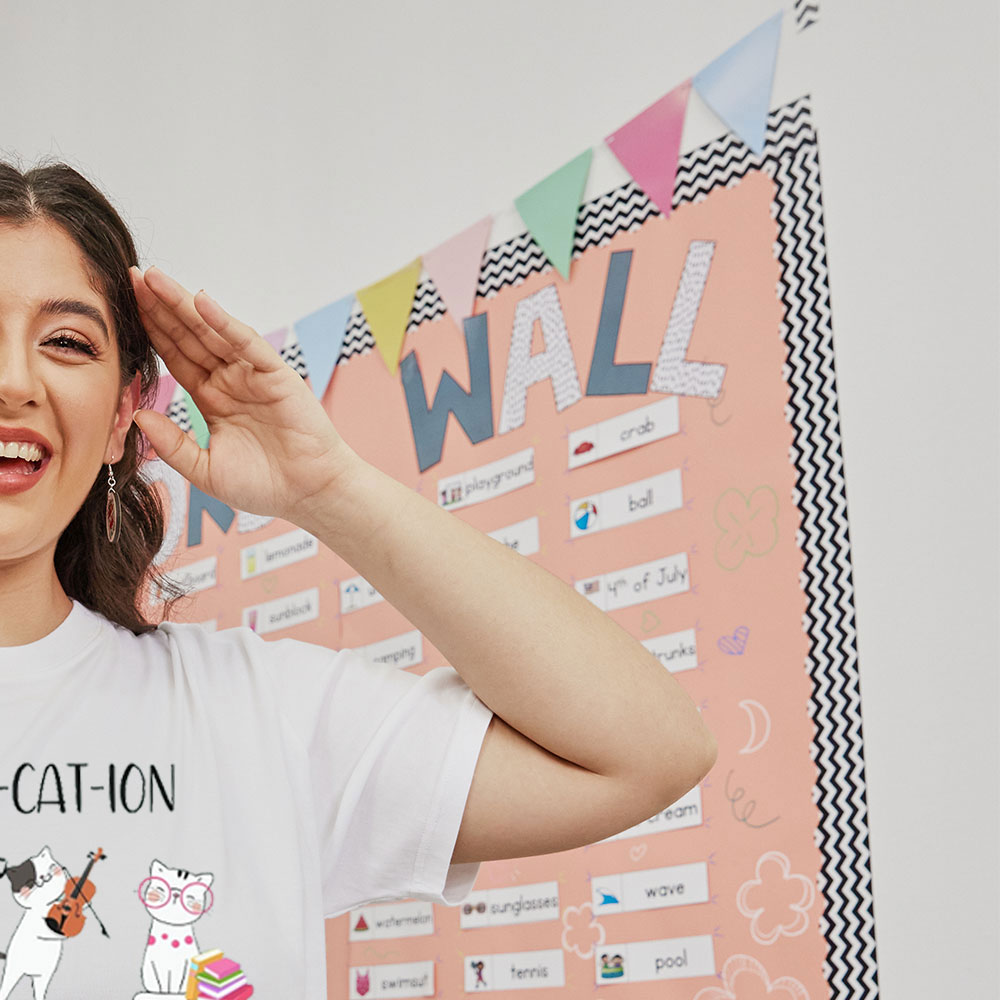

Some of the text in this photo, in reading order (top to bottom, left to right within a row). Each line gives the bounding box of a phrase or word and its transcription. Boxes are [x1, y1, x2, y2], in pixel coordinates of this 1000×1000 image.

[400, 240, 728, 474] WALL
[619, 416, 656, 443] crab
[464, 453, 535, 496] playground
[628, 488, 655, 512] ball
[265, 538, 314, 562] lemonade
[633, 571, 651, 592] of
[656, 564, 688, 586] July
[269, 602, 313, 623] sunblock
[645, 883, 686, 899] wave
[490, 895, 559, 917] sunglasses
[375, 913, 433, 928] watermelon
[510, 965, 550, 980] tennis
[655, 949, 689, 974] pool
